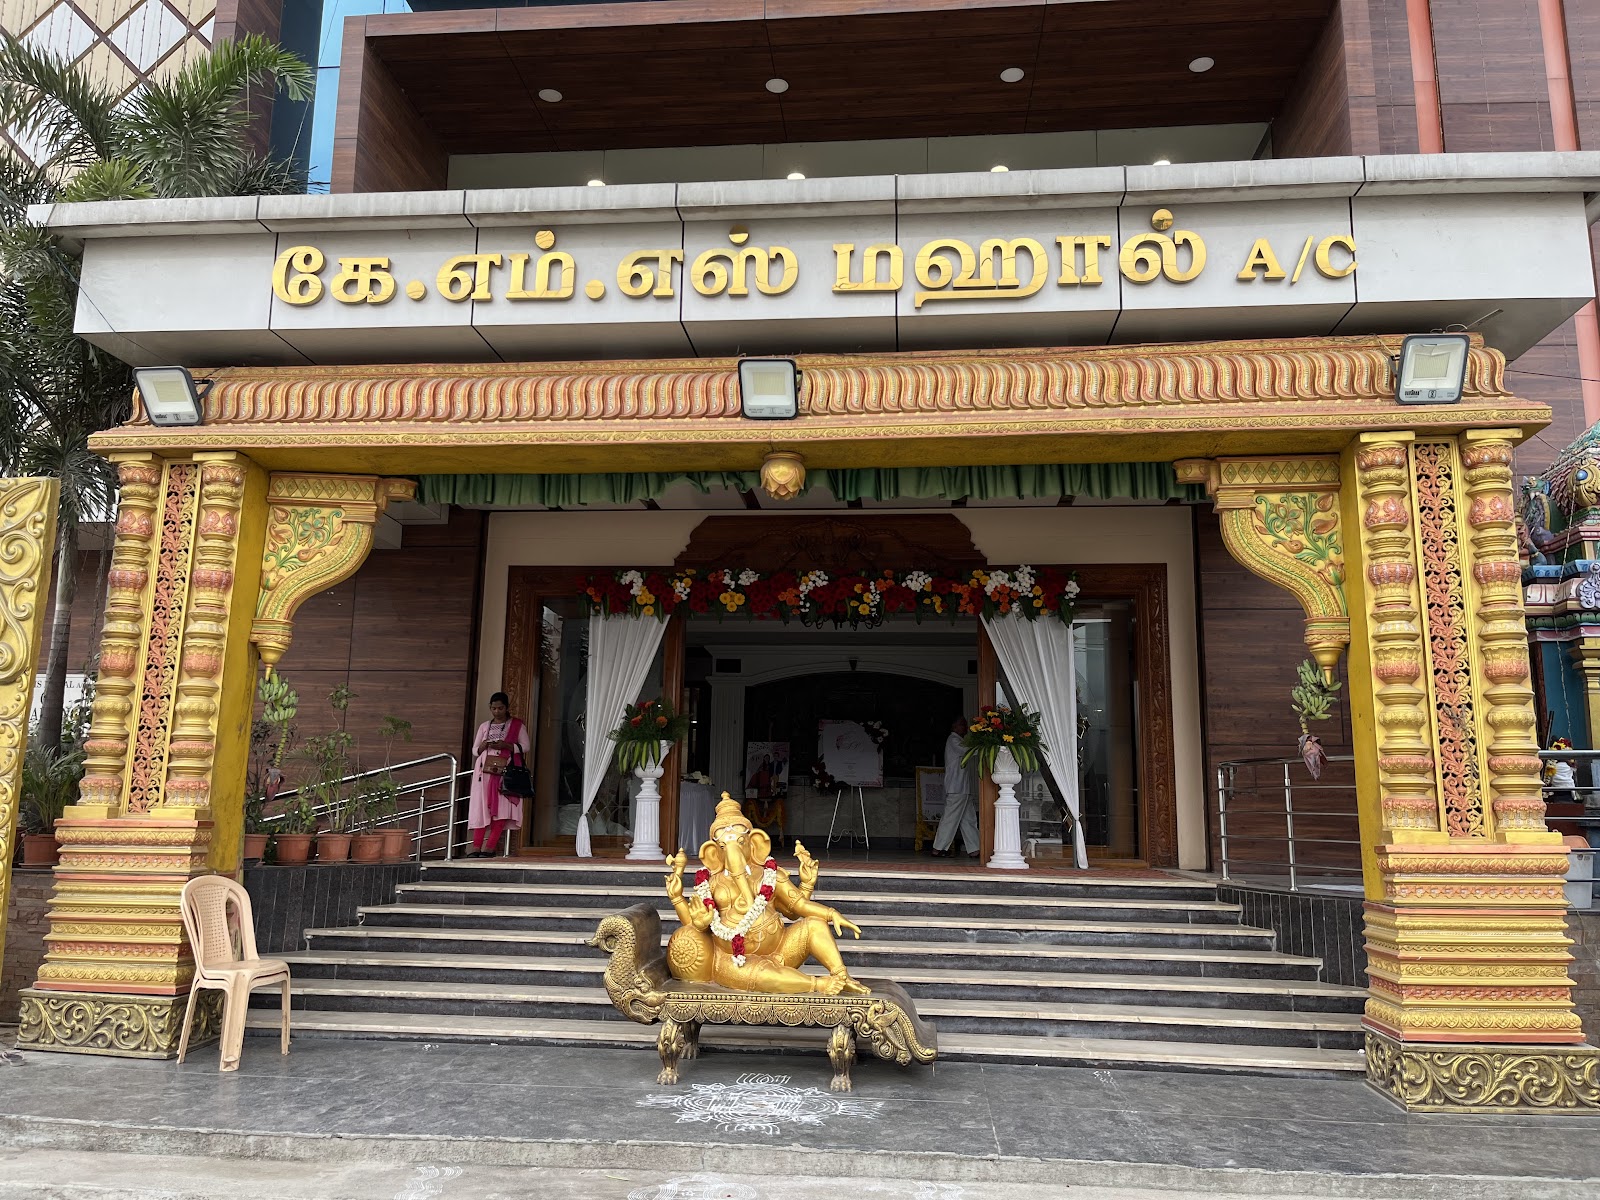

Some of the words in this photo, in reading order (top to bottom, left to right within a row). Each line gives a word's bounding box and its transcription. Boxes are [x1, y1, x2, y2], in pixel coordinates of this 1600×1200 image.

[271, 224, 800, 306] கே.எம்.எஸ்
[831, 208, 1207, 309] மஹால்
[1236, 234, 1359, 286] A/C
